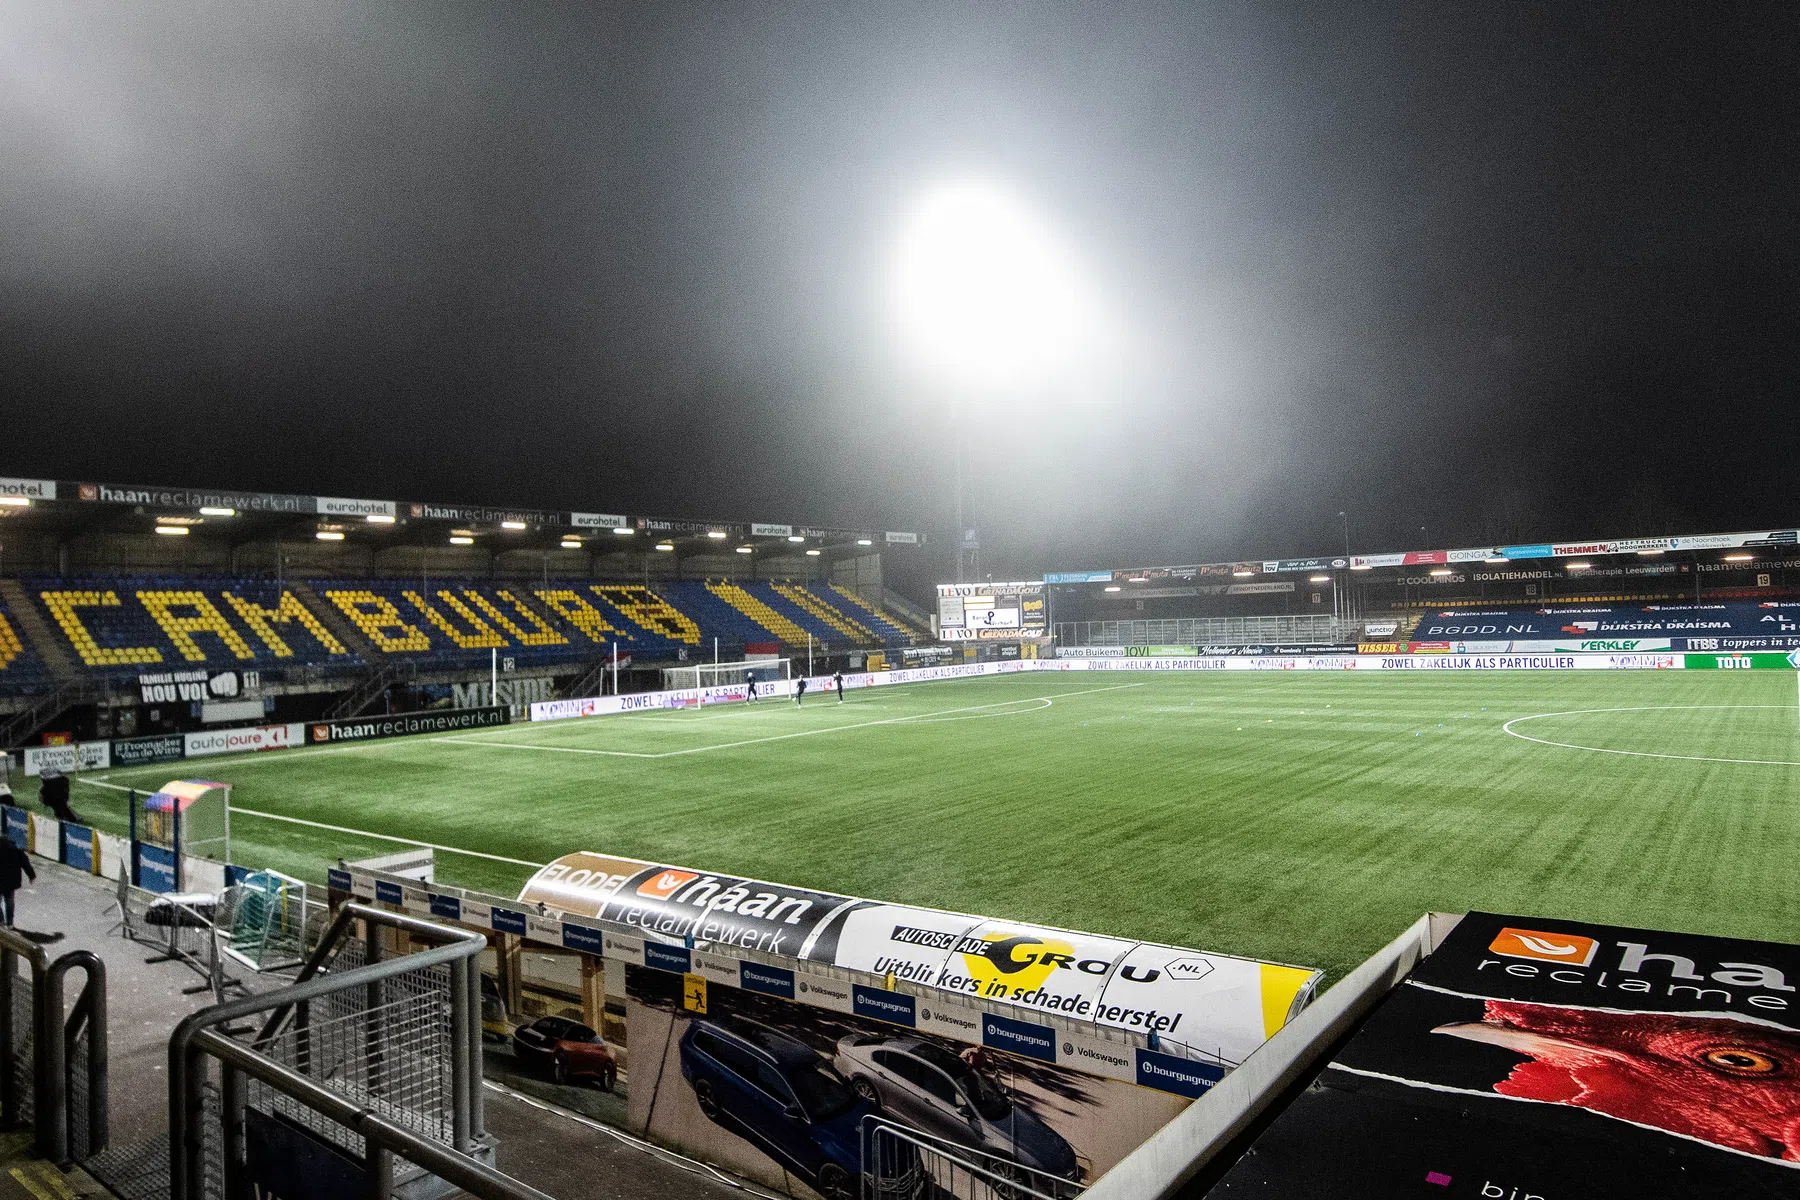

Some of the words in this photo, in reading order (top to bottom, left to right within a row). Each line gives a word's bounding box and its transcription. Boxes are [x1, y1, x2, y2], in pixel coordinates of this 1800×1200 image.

[100, 487, 301, 511] haanreclamewerk.nl
[326, 502, 387, 515] eurohotel
[424, 506, 560, 525] haanreclamewerk.nl
[1450, 551, 1487, 559] GOINGA
[1553, 544, 1606, 555] THEMMEN
[1625, 565, 1675, 574] Leeuwarden
[1407, 575, 1465, 585] COOLMINDS
[1759, 575, 1768, 584] 19
[1428, 624, 1540, 635] BGDD.NL
[1666, 622, 1732, 630] DRAISMA
[1358, 643, 1397, 654] VISSER
[1581, 641, 1641, 651] VERKLEY
[1723, 639, 1768, 649] toppers
[1771, 637, 1783, 645] in
[1064, 648, 1083, 657] Auto
[1085, 646, 1124, 656] Buikema
[503, 659, 513, 671] 12
[1088, 661, 1113, 669] ZOWEL
[1154, 661, 1170, 669] ALS
[1172, 660, 1226, 669] PARTICULIER
[1382, 659, 1416, 668] ZOWEL
[1420, 659, 1471, 668] ZAKELIJK
[1475, 659, 1496, 668] ALS
[1500, 658, 1574, 668] PARTICULIER
[1715, 657, 1752, 669] TOTO
[889, 673, 910, 683] ZOWEL
[939, 668, 950, 679] ALS
[141, 685, 177, 703] HOU
[178, 682, 210, 701] VOL
[620, 695, 653, 709] ZOWEL
[331, 711, 504, 738] haanreclamewerk.nl
[41, 745, 103, 760] Frooncker
[677, 877, 812, 925] haan
[616, 905, 788, 954] reclamewerk
[702, 961, 737, 973] Volkswagen
[750, 971, 791, 985] bourguignon
[1477, 959, 1789, 1010] reclame
[810, 985, 848, 998] Volkswagen
[873, 957, 981, 992] Uitblinkers
[985, 978, 1009, 998] in
[1010, 987, 1182, 1033] schadeherstel
[865, 998, 911, 1014] bourguignon
[933, 1013, 977, 1029] Volkswagen
[994, 1028, 1050, 1047] bourguignon
[1077, 1047, 1129, 1067] Volkswagen
